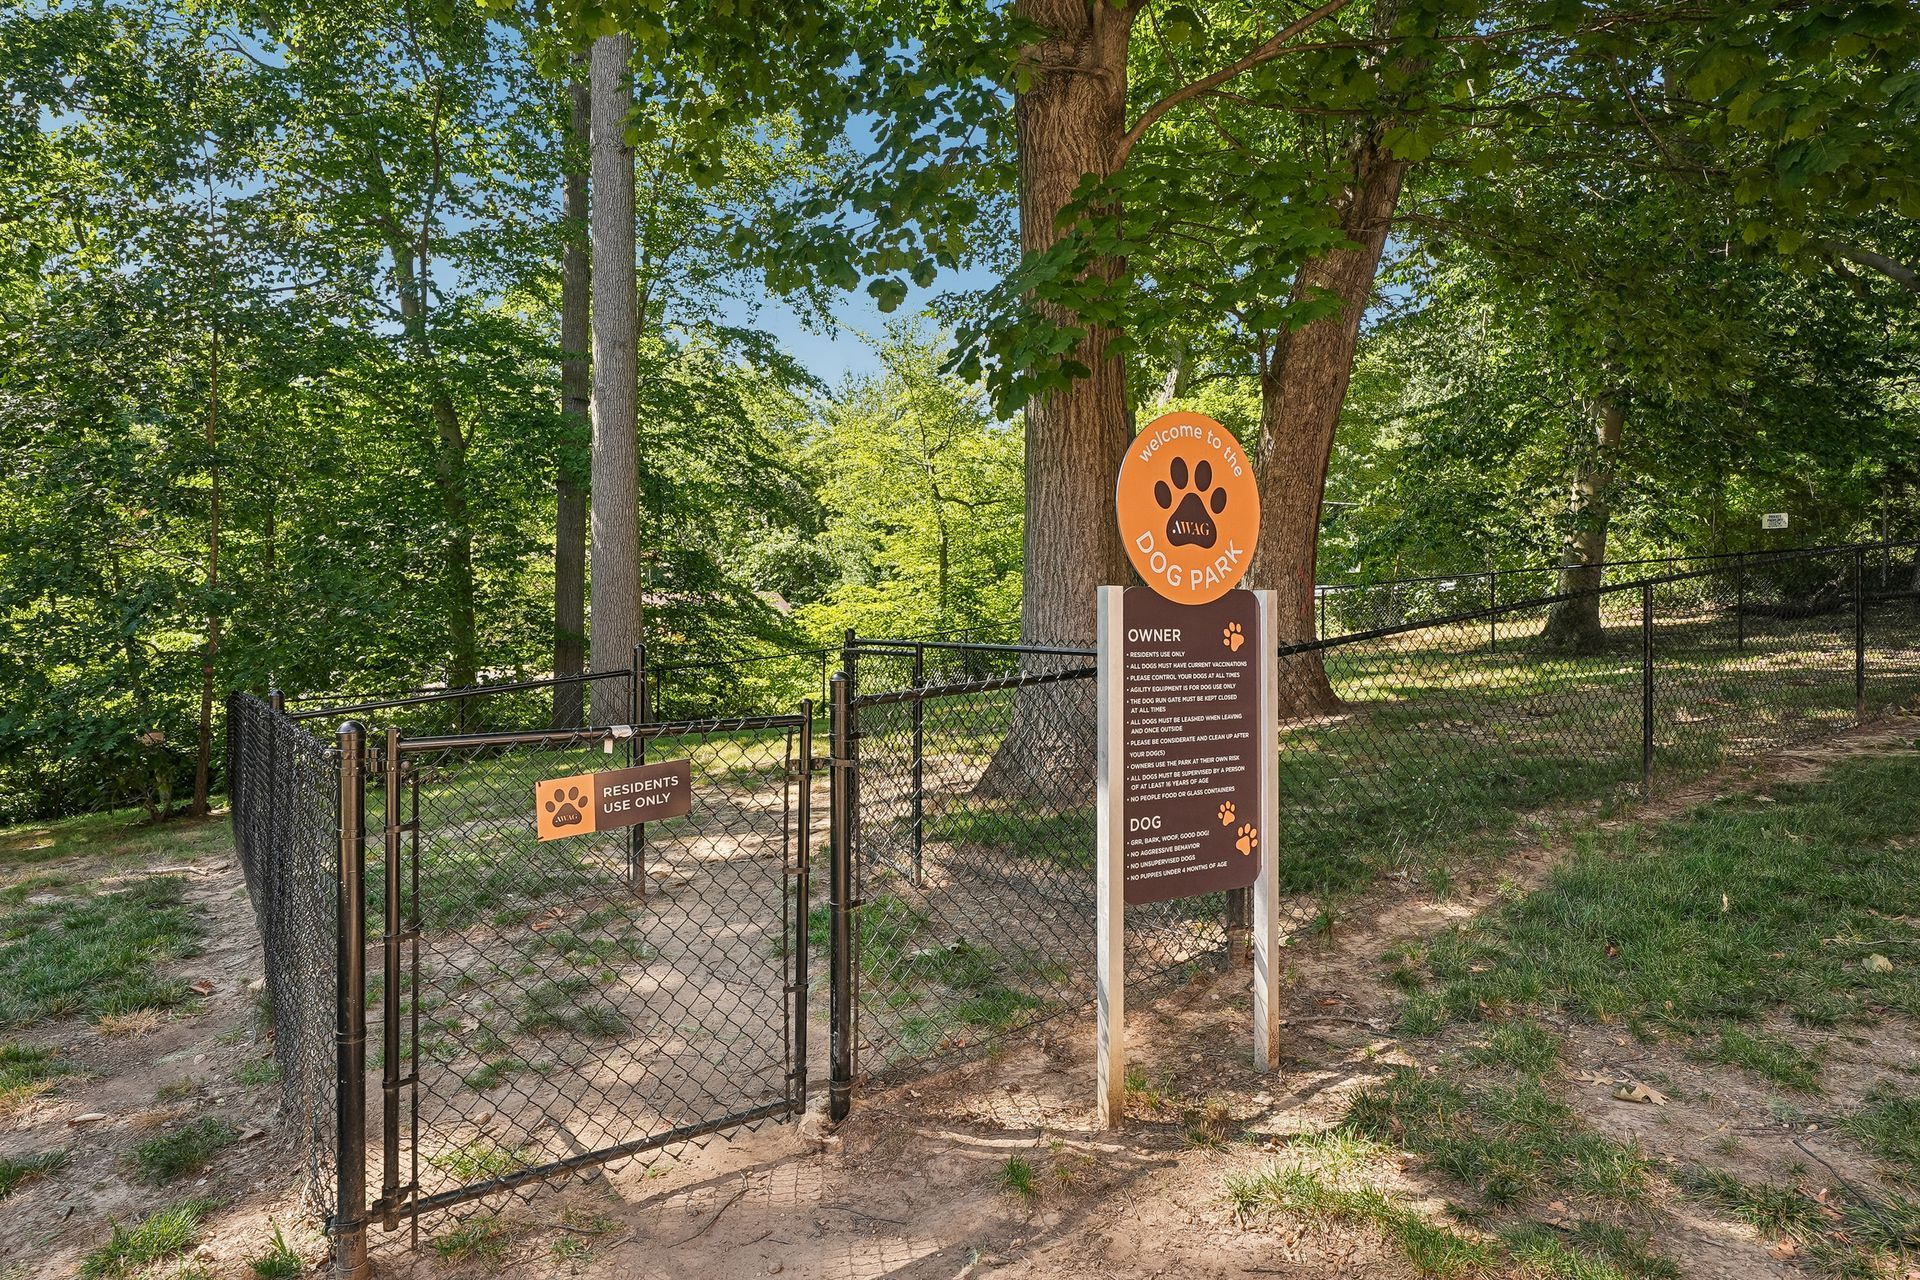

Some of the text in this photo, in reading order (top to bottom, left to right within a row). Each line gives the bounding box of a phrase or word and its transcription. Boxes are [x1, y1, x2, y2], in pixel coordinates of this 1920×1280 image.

[1139, 425, 1243, 478] welcome to the
[1172, 520, 1210, 536] AWAG
[1136, 530, 1244, 591] DOG PARK
[1128, 629, 1181, 642] OWNER
[1182, 768, 1212, 776] SUPERVISED
[603, 776, 679, 798] RESIDENTS
[1204, 786, 1236, 794] CONTAINERS
[603, 793, 671, 814] USE ONLY
[1130, 816, 1162, 832] DOG
[1180, 832, 1196, 840] GOOD
[1174, 842, 1200, 852] BEHAVIOR
[1140, 870, 1162, 880] PUPPIES
[1162, 868, 1182, 876] UNDER
[1186, 864, 1208, 872] MONTHS
